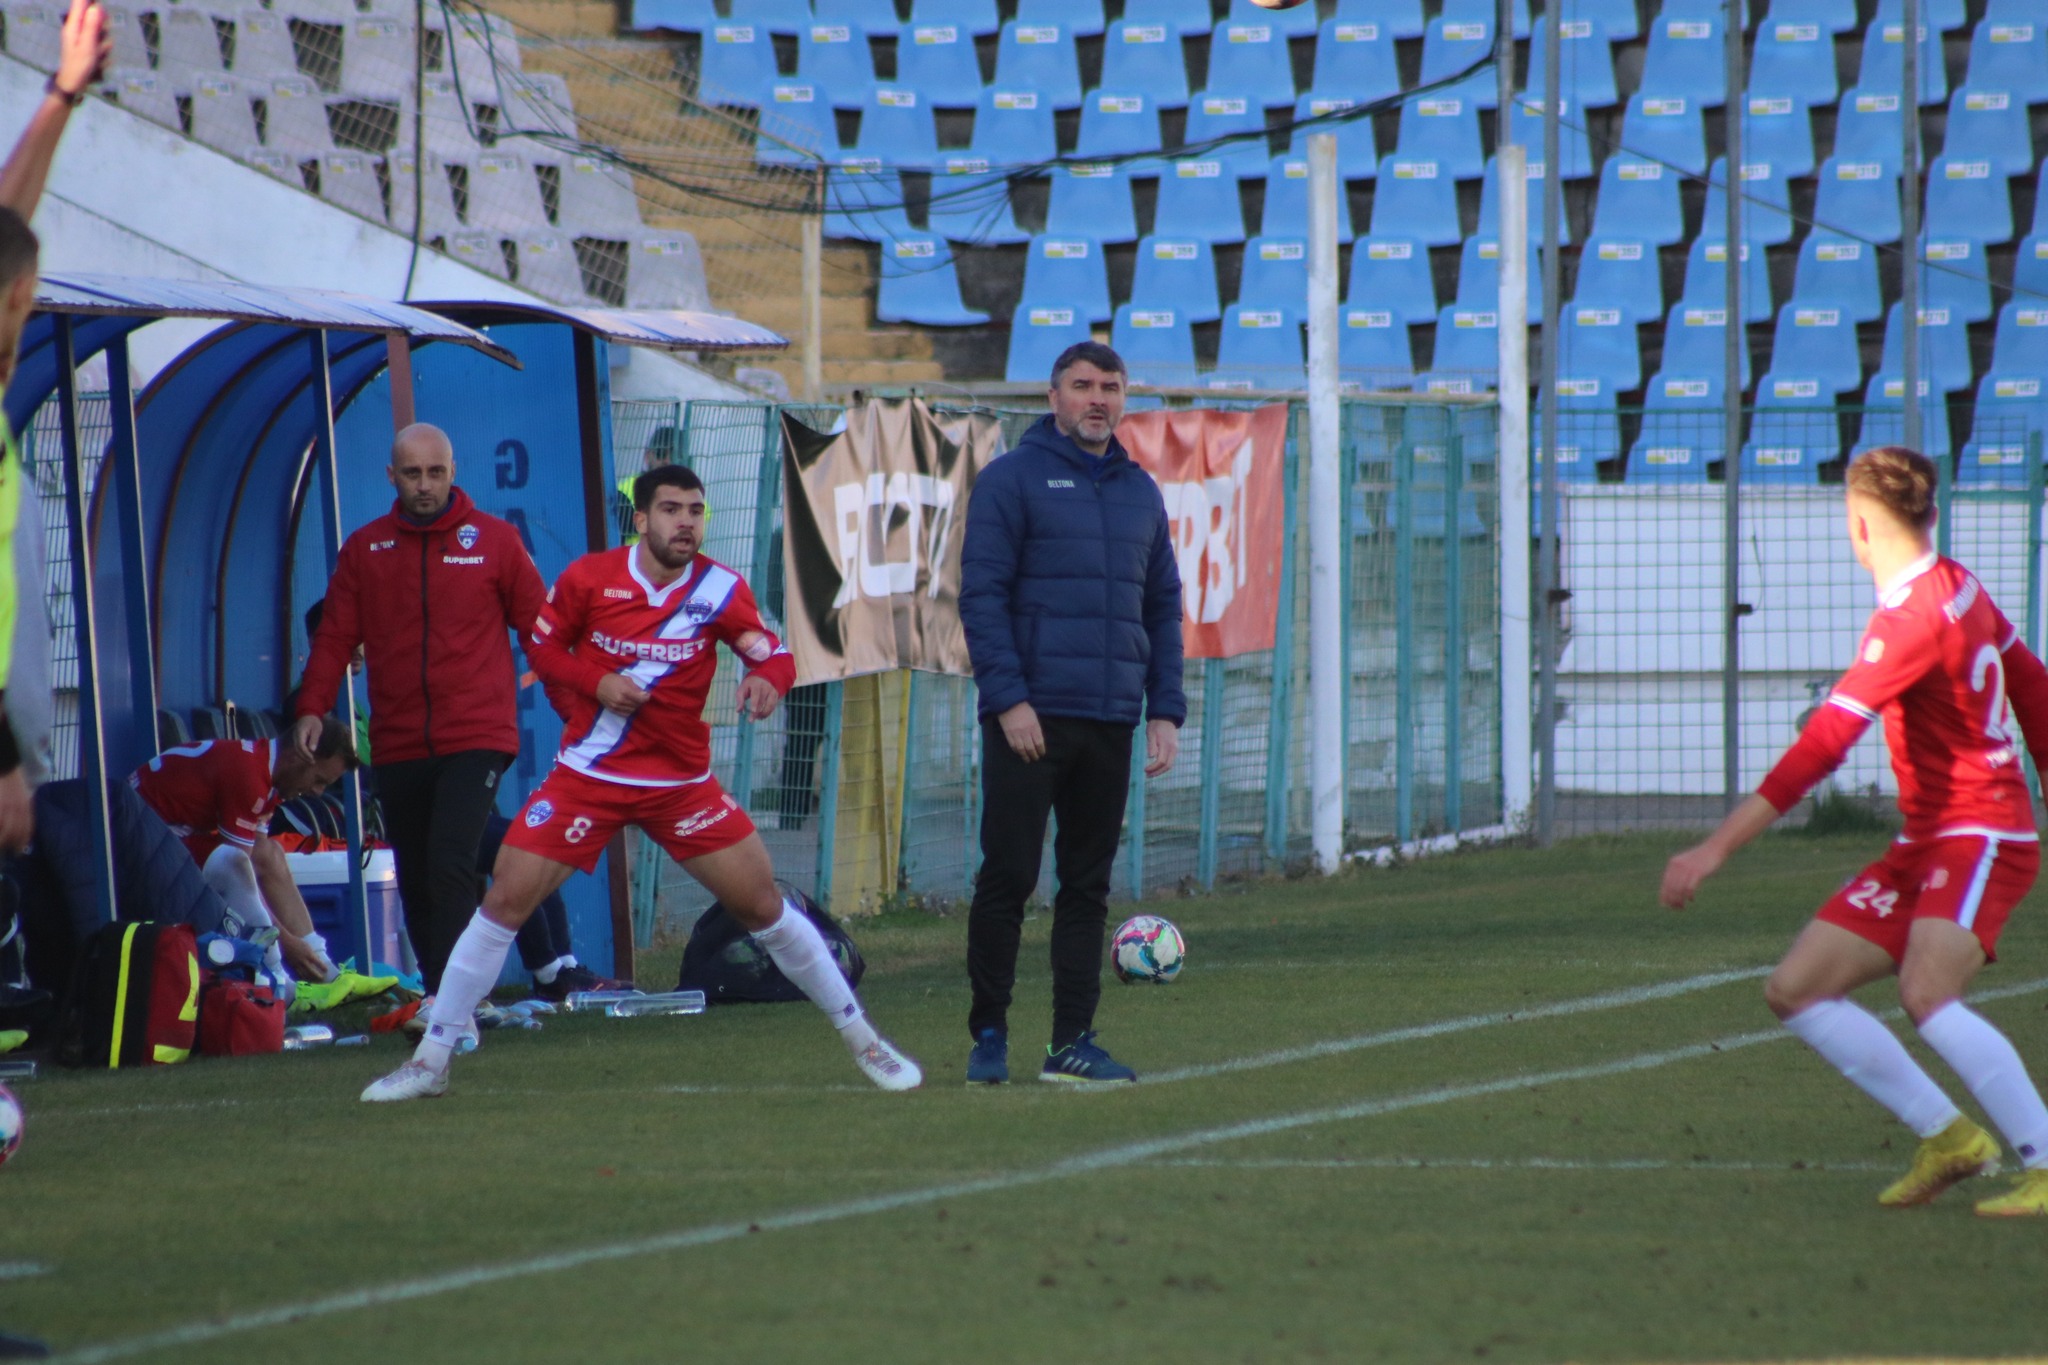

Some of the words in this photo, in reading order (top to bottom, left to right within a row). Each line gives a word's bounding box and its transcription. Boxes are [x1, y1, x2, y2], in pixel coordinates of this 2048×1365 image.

[1047, 479, 1075, 488] BELTONA
[443, 555, 484, 565] SUPERBET
[604, 588, 632, 599] BELTONA
[591, 631, 706, 661] SUPERBET
[565, 817, 592, 843] 8
[1847, 881, 1900, 918] 24
